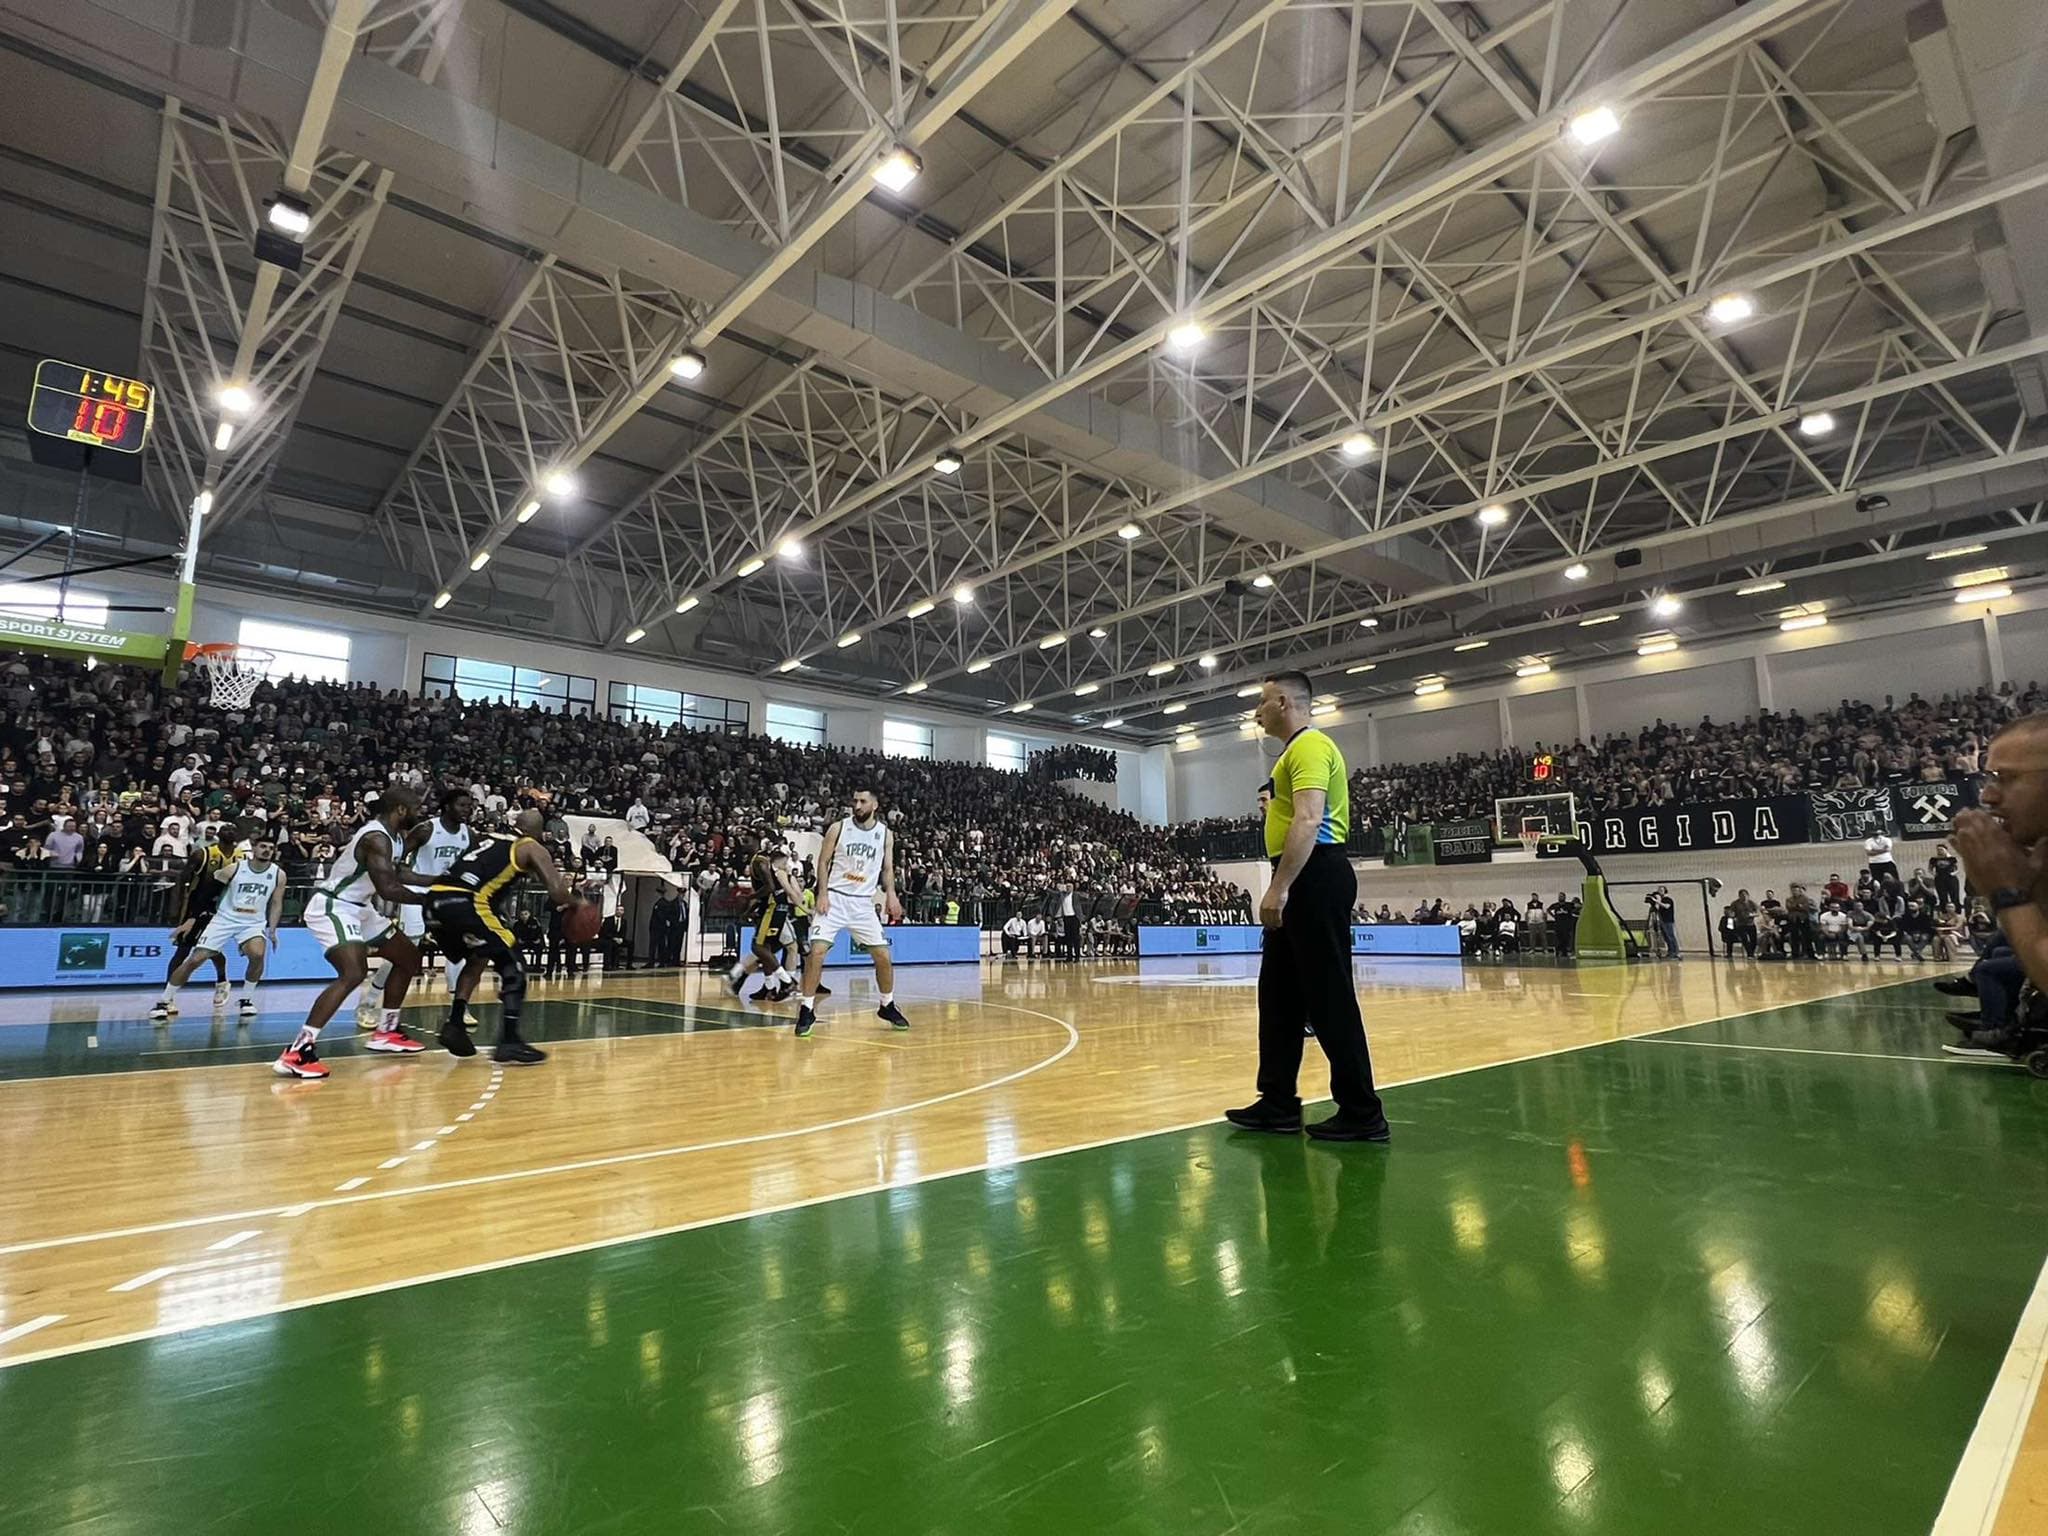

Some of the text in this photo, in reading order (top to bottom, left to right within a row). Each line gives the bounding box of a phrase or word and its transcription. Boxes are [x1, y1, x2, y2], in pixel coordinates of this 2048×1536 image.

[80, 371, 146, 409] 1:45
[74, 399, 126, 440] 10
[0, 620, 127, 646] SPORT SYSTEM
[1534, 765, 1549, 778] 10
[346, 924, 361, 936] 15
[112, 945, 161, 958] TEB
